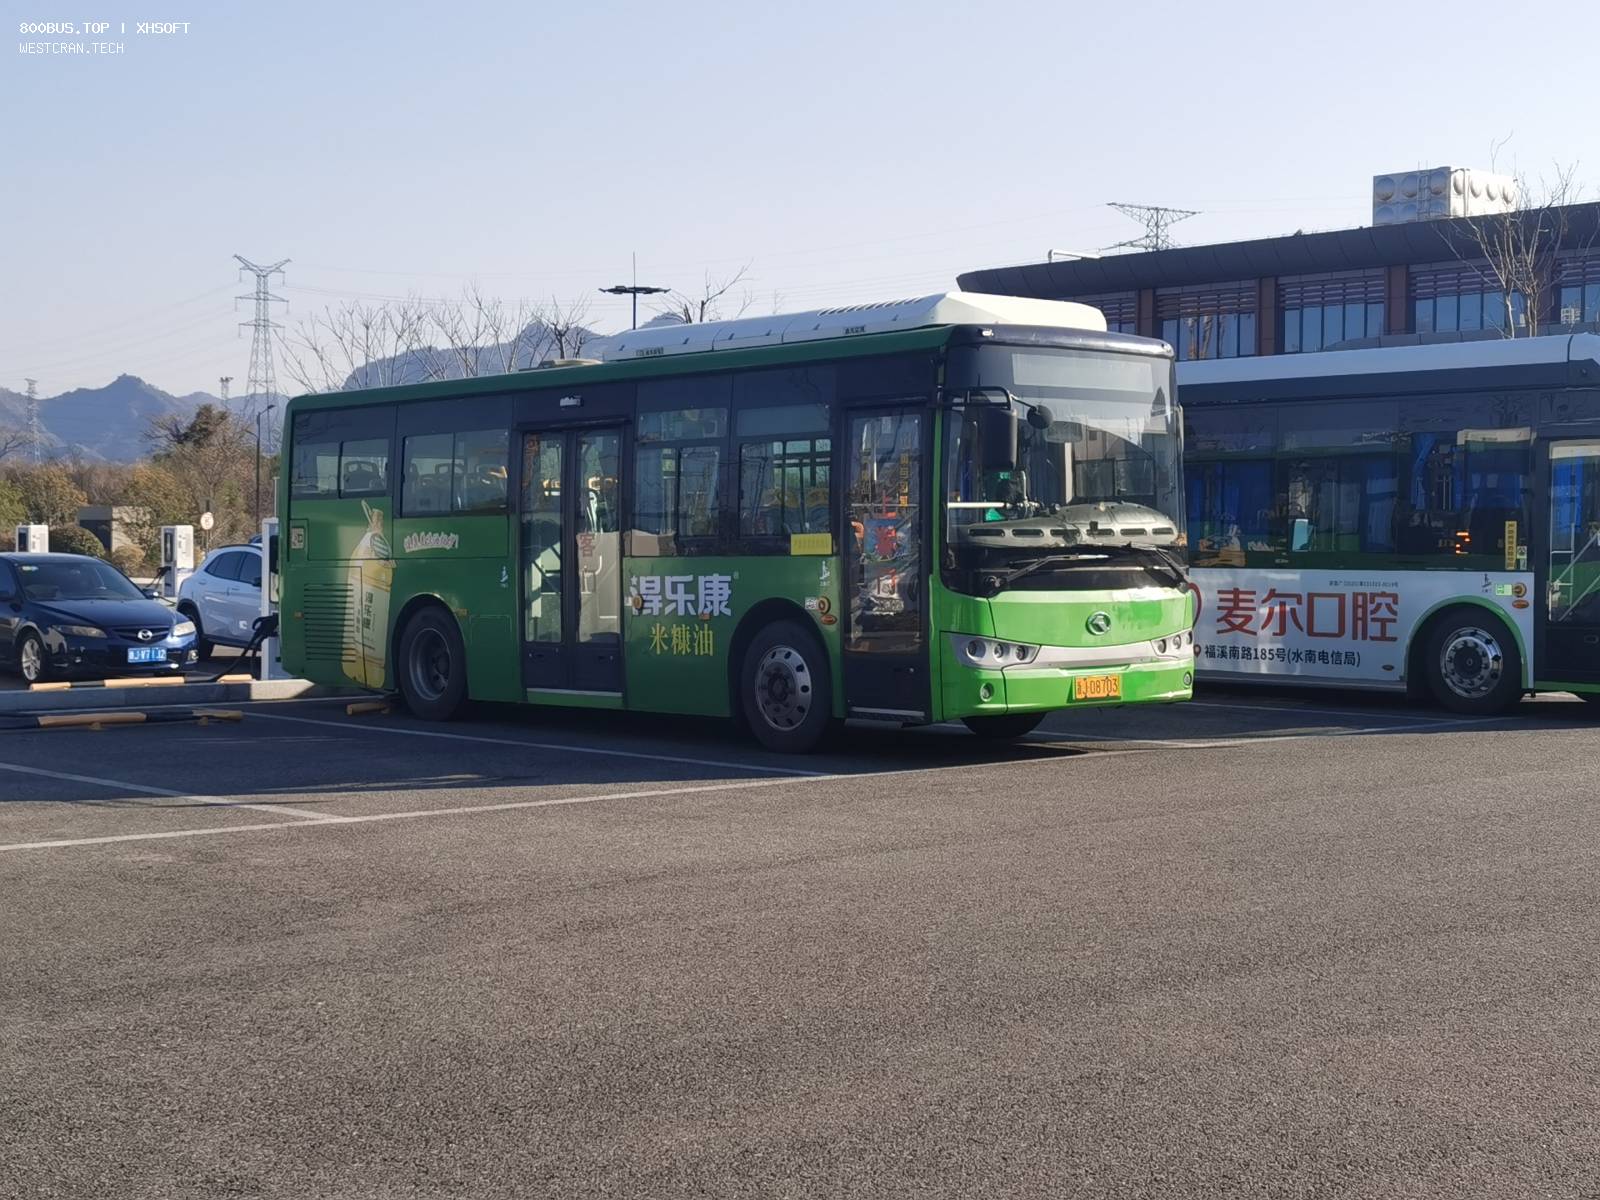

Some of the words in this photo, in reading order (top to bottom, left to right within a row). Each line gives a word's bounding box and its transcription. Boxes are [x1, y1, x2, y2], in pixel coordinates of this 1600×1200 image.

[630, 573, 732, 617] 得乐康
[1216, 587, 1399, 642] 麦尔口腔
[649, 623, 714, 657] 米糠油
[1205, 645, 1361, 668] 福溪南路185号(水南电信局)
